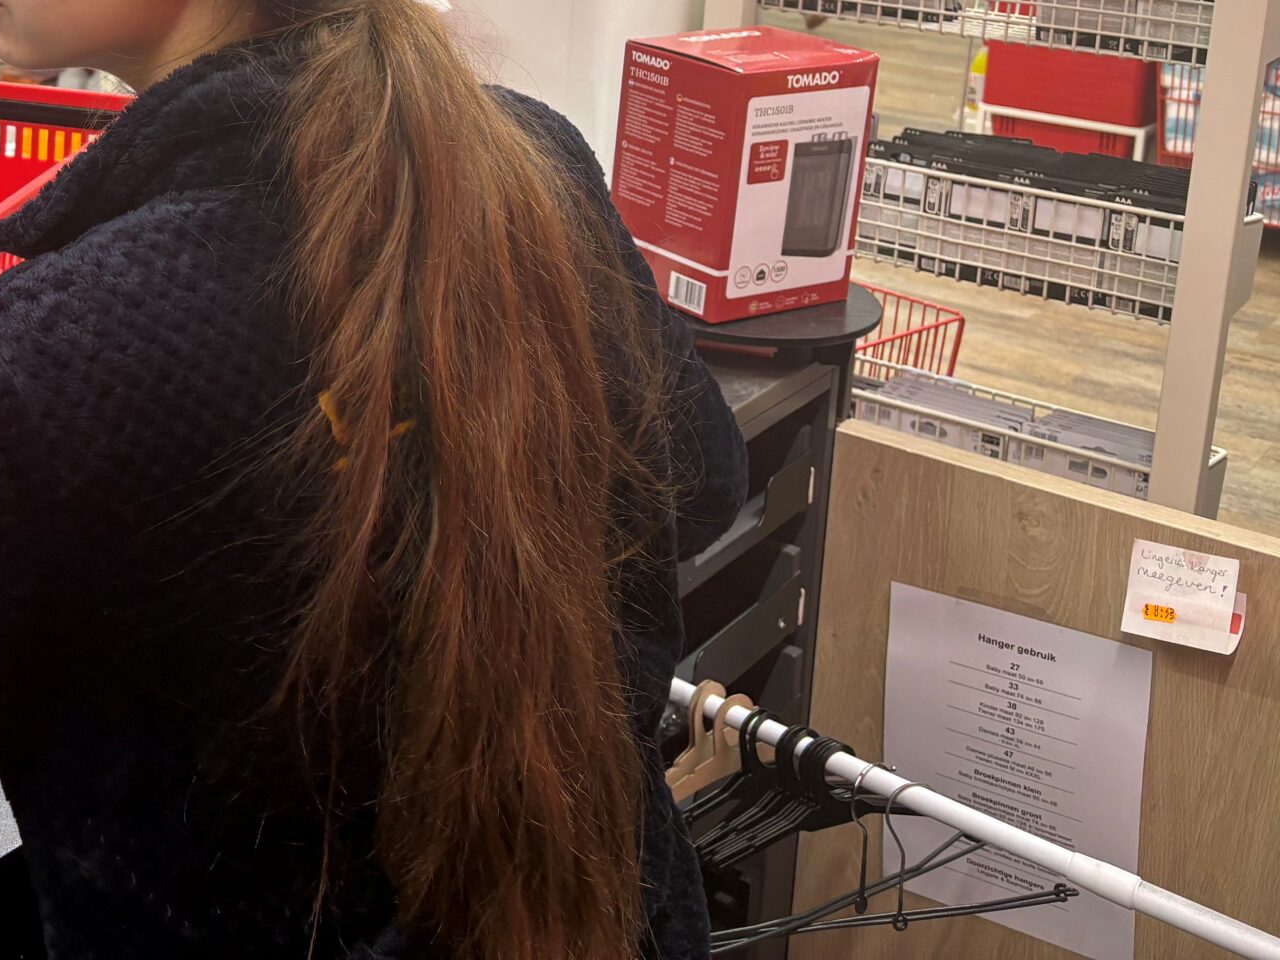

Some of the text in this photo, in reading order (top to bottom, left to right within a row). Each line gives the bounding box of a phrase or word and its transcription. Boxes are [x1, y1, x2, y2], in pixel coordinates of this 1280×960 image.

[631, 50, 670, 71] TOMADO
[630, 66, 669, 86] THC1501B
[786, 70, 840, 88] TOMADO
[754, 105, 794, 118] THC1501B
[870, 143, 885, 152] AAA
[931, 161, 947, 170] AAA
[1013, 176, 1030, 185] AAA
[1114, 196, 1132, 205] AAA
[1141, 549, 1185, 569] Lingerie
[977, 632, 1057, 662] Hanger gebruik
[986, 664, 1001, 674] Baby
[1002, 668, 1017, 678] maat
[1009, 662, 1020, 671] 27
[984, 683, 1000, 693] Baby
[1001, 688, 1016, 697] maat
[1008, 681, 1019, 690] 33
[979, 701, 998, 712] Kinder
[1007, 701, 1017, 710] 38
[978, 726, 999, 737] Dames
[1005, 726, 1016, 735] 43
[1034, 723, 1045, 732] 170
[966, 745, 986, 756] Dames
[1011, 760, 1027, 769] maat
[1003, 749, 1014, 758] 47
[974, 768, 1042, 796] Broekpinnen klein
[972, 792, 1042, 820] Broekpinnen groot
[966, 857, 1013, 879] Doorzichtige
[1014, 874, 1045, 890] hangers
